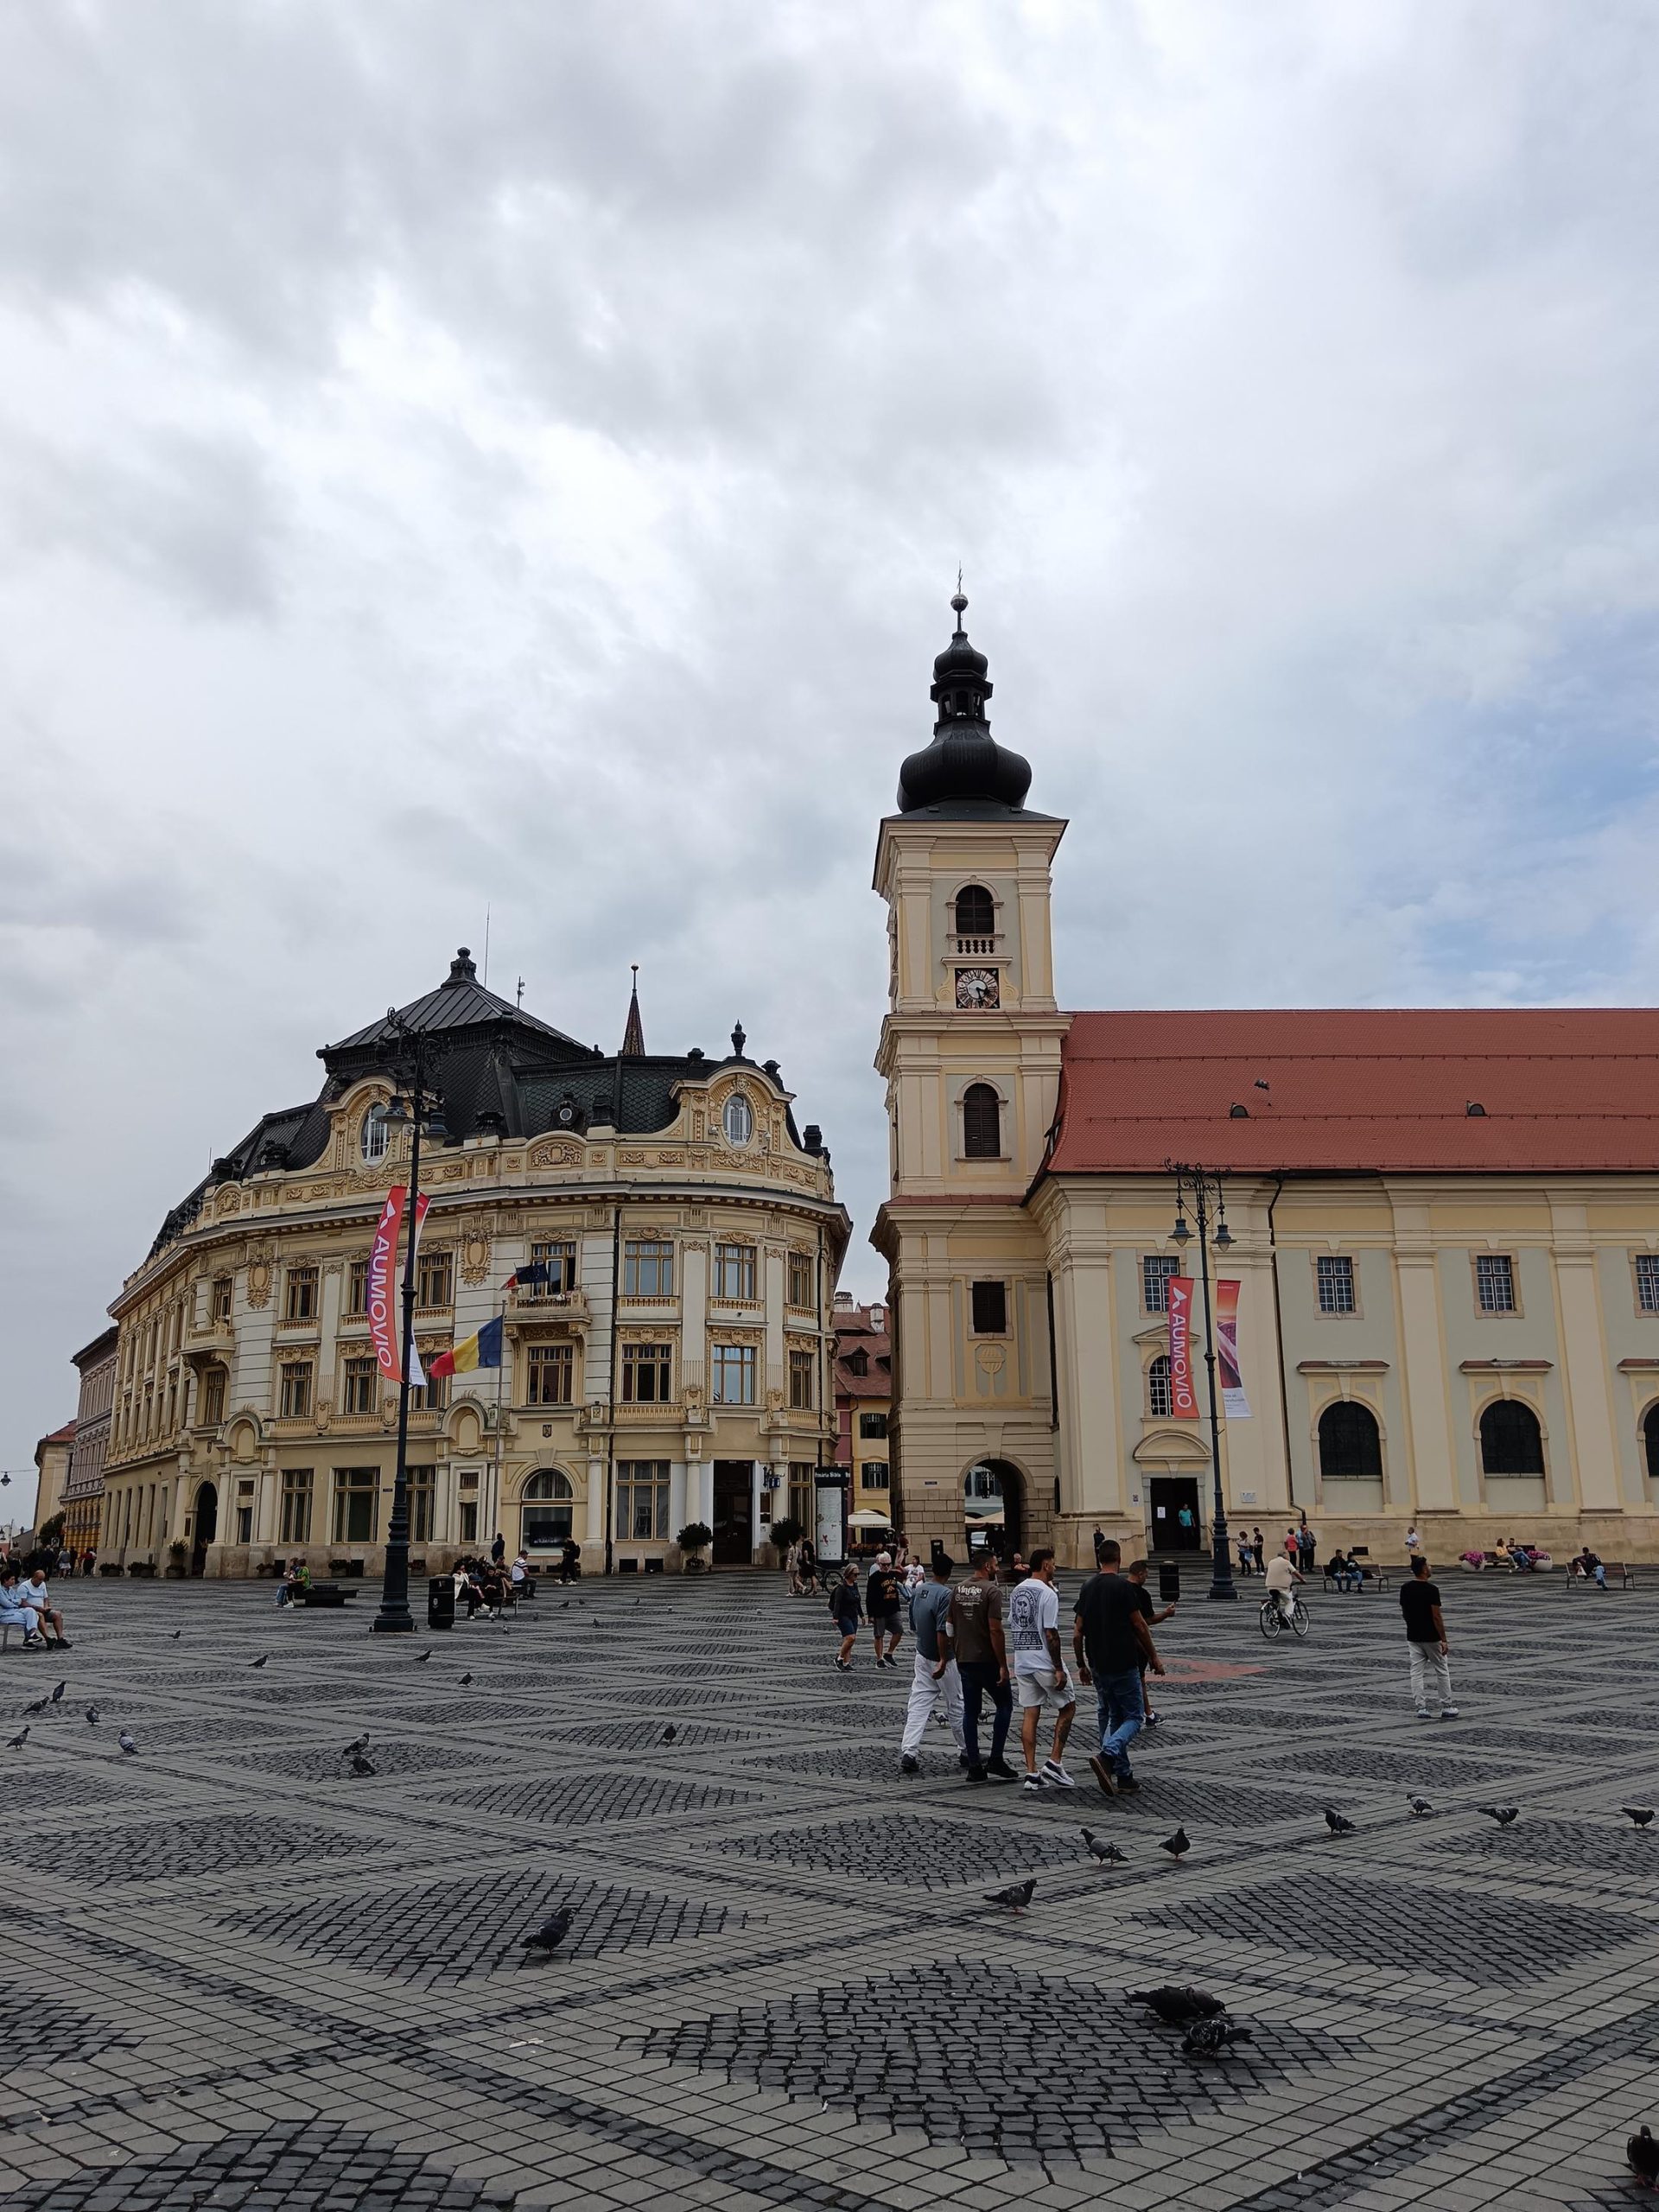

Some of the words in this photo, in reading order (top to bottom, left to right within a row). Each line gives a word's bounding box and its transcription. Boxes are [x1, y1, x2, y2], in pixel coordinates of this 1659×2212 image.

[371, 1235, 392, 1369] AUMOVIO
[1172, 1313, 1192, 1408] AUMOVIO
[957, 1586, 982, 1596] Vintage
